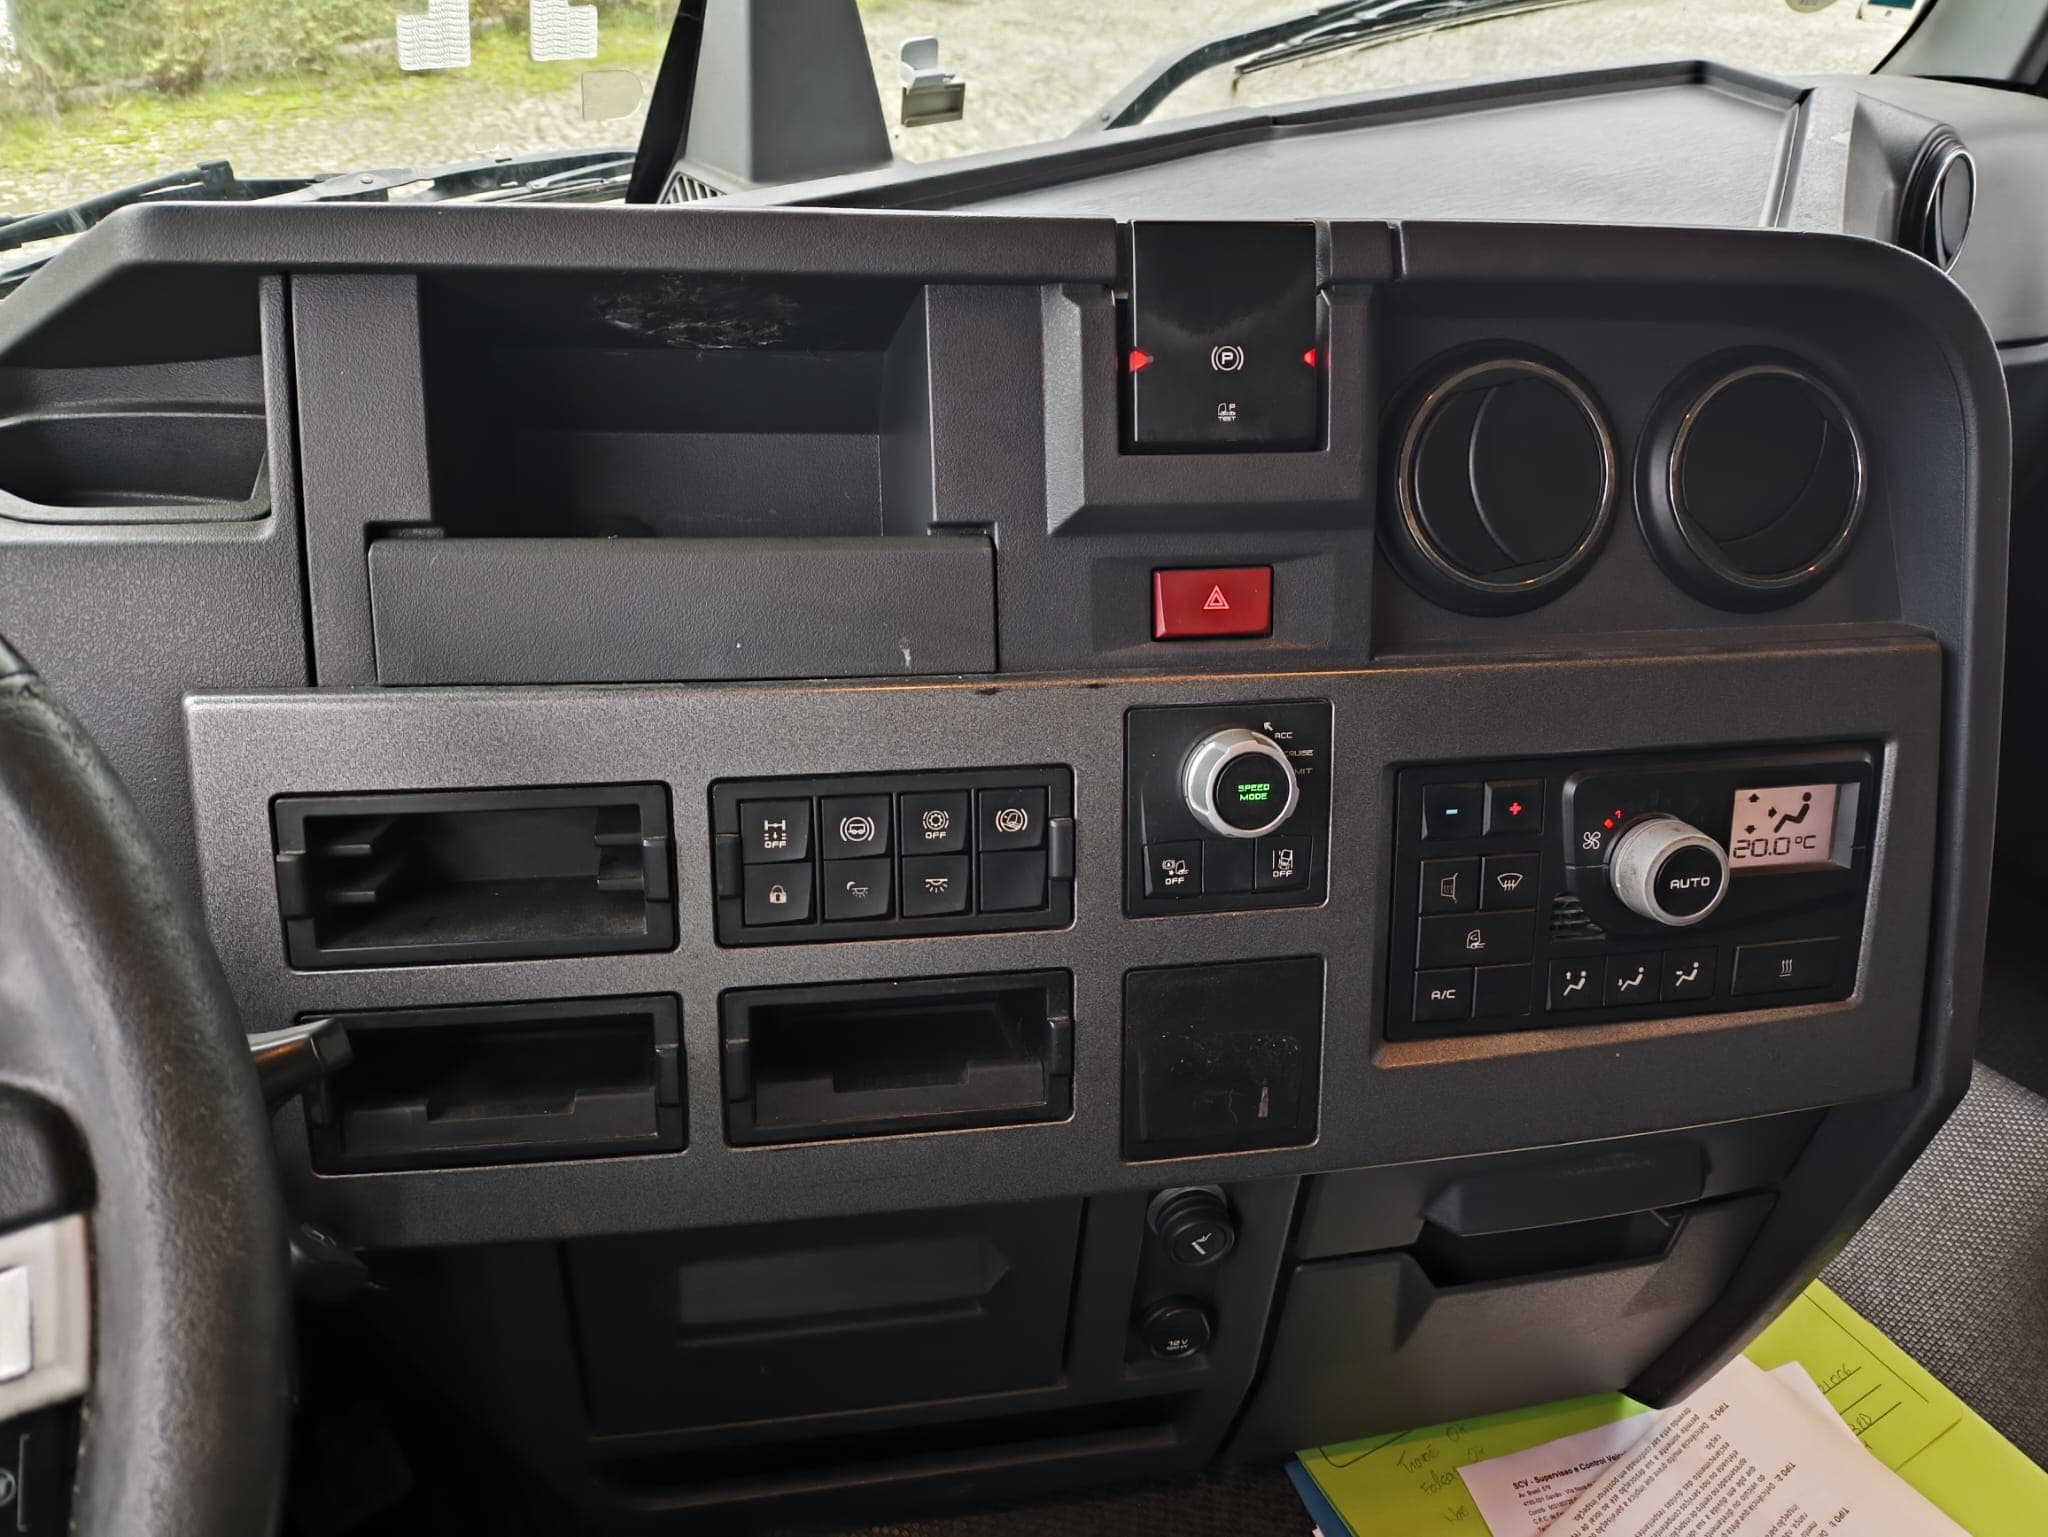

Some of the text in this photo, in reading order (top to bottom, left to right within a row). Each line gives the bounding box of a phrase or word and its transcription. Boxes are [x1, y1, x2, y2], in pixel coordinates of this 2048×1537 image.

[1274, 732, 1293, 740] ACC
[1238, 784, 1270, 792] SPEED
[1240, 793, 1268, 801] MODE
[925, 831, 947, 840] OFF
[764, 840, 787, 849] OFF
[1164, 877, 1185, 886] OFF
[1272, 870, 1292, 878] OFF
[1670, 876, 1710, 890] AUTO
[1431, 989, 1456, 1000] A/C
[1714, 1401, 1729, 1416] TIPO
[1670, 1406, 1690, 1428] devendo
[1679, 1413, 1699, 1434] permite
[1659, 1426, 1671, 1438] esta
[1681, 1421, 1708, 1450] Deficiência
[1650, 1436, 1660, 1446] ser
[1658, 1432, 1680, 1456] somente
[1703, 1432, 1722, 1452] cação.
[1626, 1444, 1652, 1472] confirmada
[1666, 1447, 1683, 1465] muito
[1692, 1440, 1730, 1481] esclarecimento
[1715, 1449, 1739, 1474] efetuada
[1644, 1459, 1654, 1469] sua
[1653, 1462, 1668, 1477] grave
[1744, 1465, 1756, 1477] que
[1780, 1460, 1795, 1476] TIPO
[1513, 1479, 1528, 1489] SCV
[1579, 1457, 1605, 1470] Control
[1643, 1474, 1654, 1486] que
[1716, 1457, 1747, 1490] apresentado
[1756, 1474, 1766, 1483] do
[1596, 1476, 1619, 1501] posterior
[1617, 1466, 1646, 1496] deslocação
[1682, 1479, 1694, 1491] das
[1699, 1478, 1711, 1490] nos
[1735, 1475, 1748, 1488] põe
[1609, 1494, 1619, 1504] até
[1627, 1483, 1646, 1504] implica
[1664, 1488, 1684, 1510] dúvidas
[1726, 1486, 1736, 1497] em
[1739, 1481, 1759, 1502] veículo
[1747, 1482, 1775, 1511] Deficiência
[1679, 1488, 1701, 1511] serviços
[1695, 1493, 1713, 1512] centro
[1710, 1496, 1728, 1516] dúvida
[1732, 1499, 1741, 1509] ou
[1588, 1510, 1602, 1525] local
[1594, 1504, 1625, 1536] paralisação
[1738, 1508, 1750, 1521] que
[1774, 1502, 1800, 1529] inspeção
[1833, 1506, 1849, 1523] TIPO
[1695, 1519, 1705, 1529] sua
[1726, 1519, 1742, 1535] afeta
